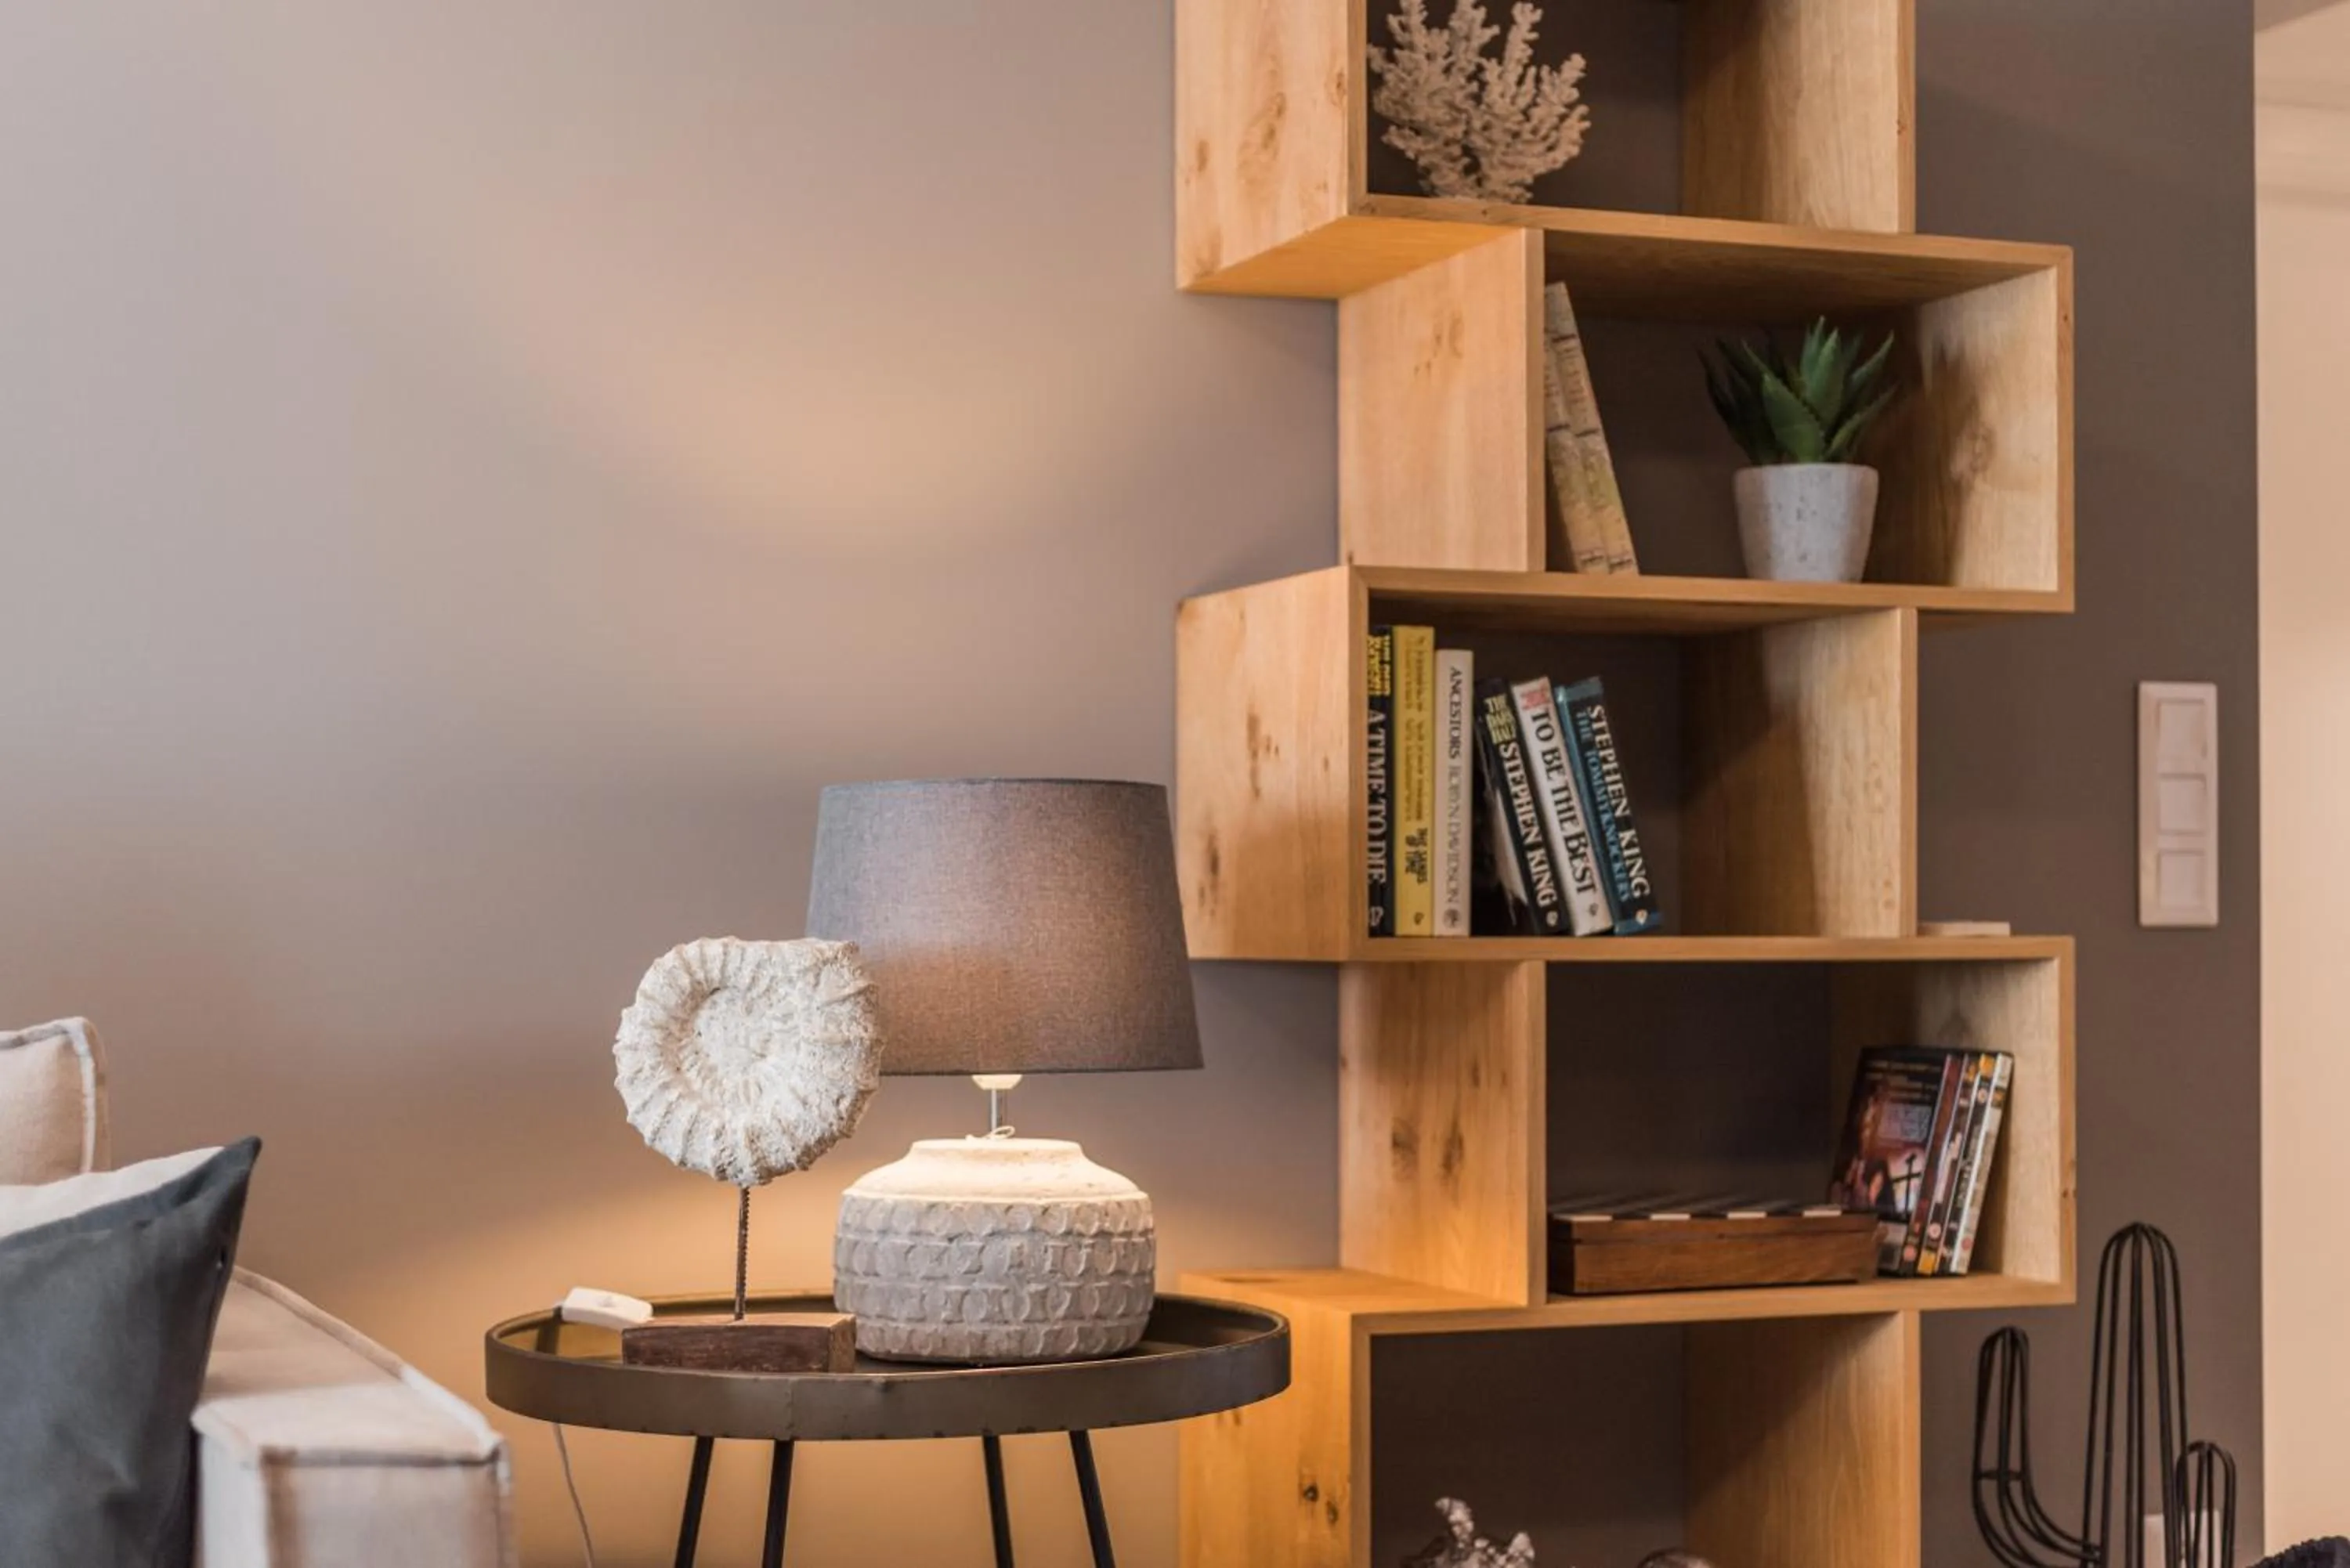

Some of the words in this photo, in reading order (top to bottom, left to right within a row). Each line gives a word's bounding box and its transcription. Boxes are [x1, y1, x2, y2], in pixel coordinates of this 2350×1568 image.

[1368, 709, 1386, 728] A
[1448, 667, 1463, 760] ANCESTORS
[1531, 707, 1555, 742] TO
[1368, 728, 1386, 793] TIME
[1541, 747, 1566, 782] BE
[1368, 797, 1386, 836] TO
[1499, 741, 1542, 847] STEPHEN
[1525, 847, 1558, 909] KING
[1550, 784, 1580, 834] THE
[1575, 711, 1591, 745] THE
[1584, 750, 1631, 902] TOMMYKNOCKERS
[1587, 705, 1631, 818] STEPHEN
[1618, 828, 1651, 898] KING
[1368, 840, 1386, 884] DIE
[1565, 833, 1597, 896] BEST
